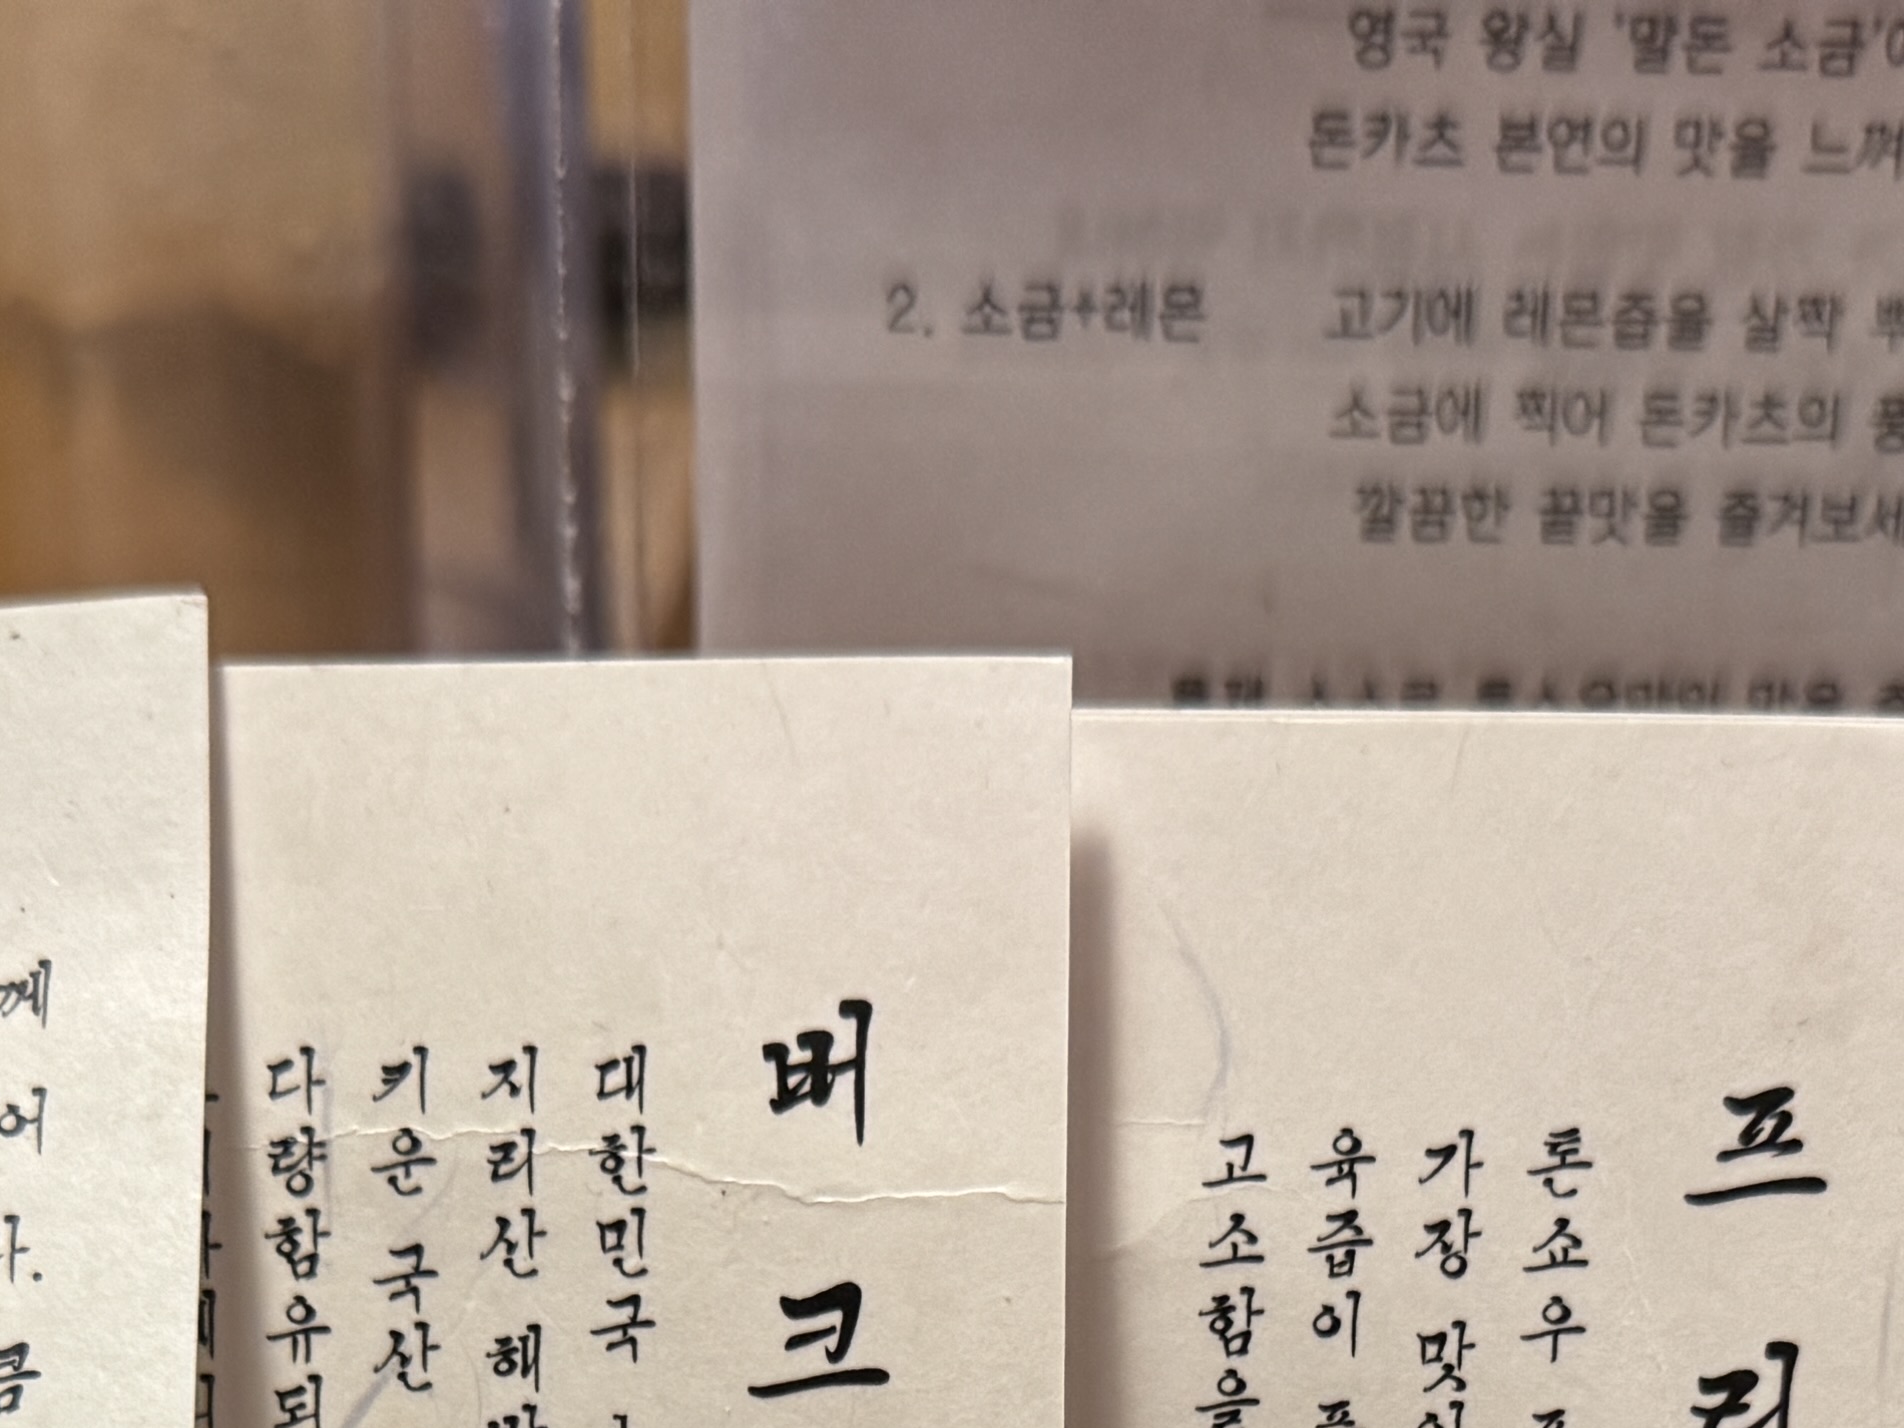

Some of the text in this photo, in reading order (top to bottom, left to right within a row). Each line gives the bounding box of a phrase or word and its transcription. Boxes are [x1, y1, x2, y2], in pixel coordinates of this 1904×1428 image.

[1346, 6, 1452, 70] 영국
[1480, 6, 1585, 72] 왕실
[1307, 109, 1466, 170] 돈카츠
[1493, 113, 1649, 177] 본연의
[1673, 116, 1777, 178] 맛을
[886, 281, 934, 338] 2.
[960, 278, 1208, 344] 소금+레몬
[1322, 285, 1479, 349] 고기에
[1502, 285, 1713, 353] 레몬즙을
[1738, 292, 1845, 356] 살짝
[1326, 385, 1484, 448] 소금에
[1513, 387, 1613, 448] 찍어
[1637, 389, 1845, 451] 돈카츠의
[1351, 482, 1510, 546] 깔끔한
[1536, 486, 1690, 547] 끝맛을
[370, 1044, 437, 1196] 키운
[480, 1043, 548, 1279] 지리산
[587, 1043, 657, 1364] 대한민국
[1307, 1126, 1376, 1358] 육즙이
[1414, 1127, 1484, 1280] 가장
[1520, 1126, 1594, 1363] 톤쇼우
[372, 1242, 441, 1392] 국산
